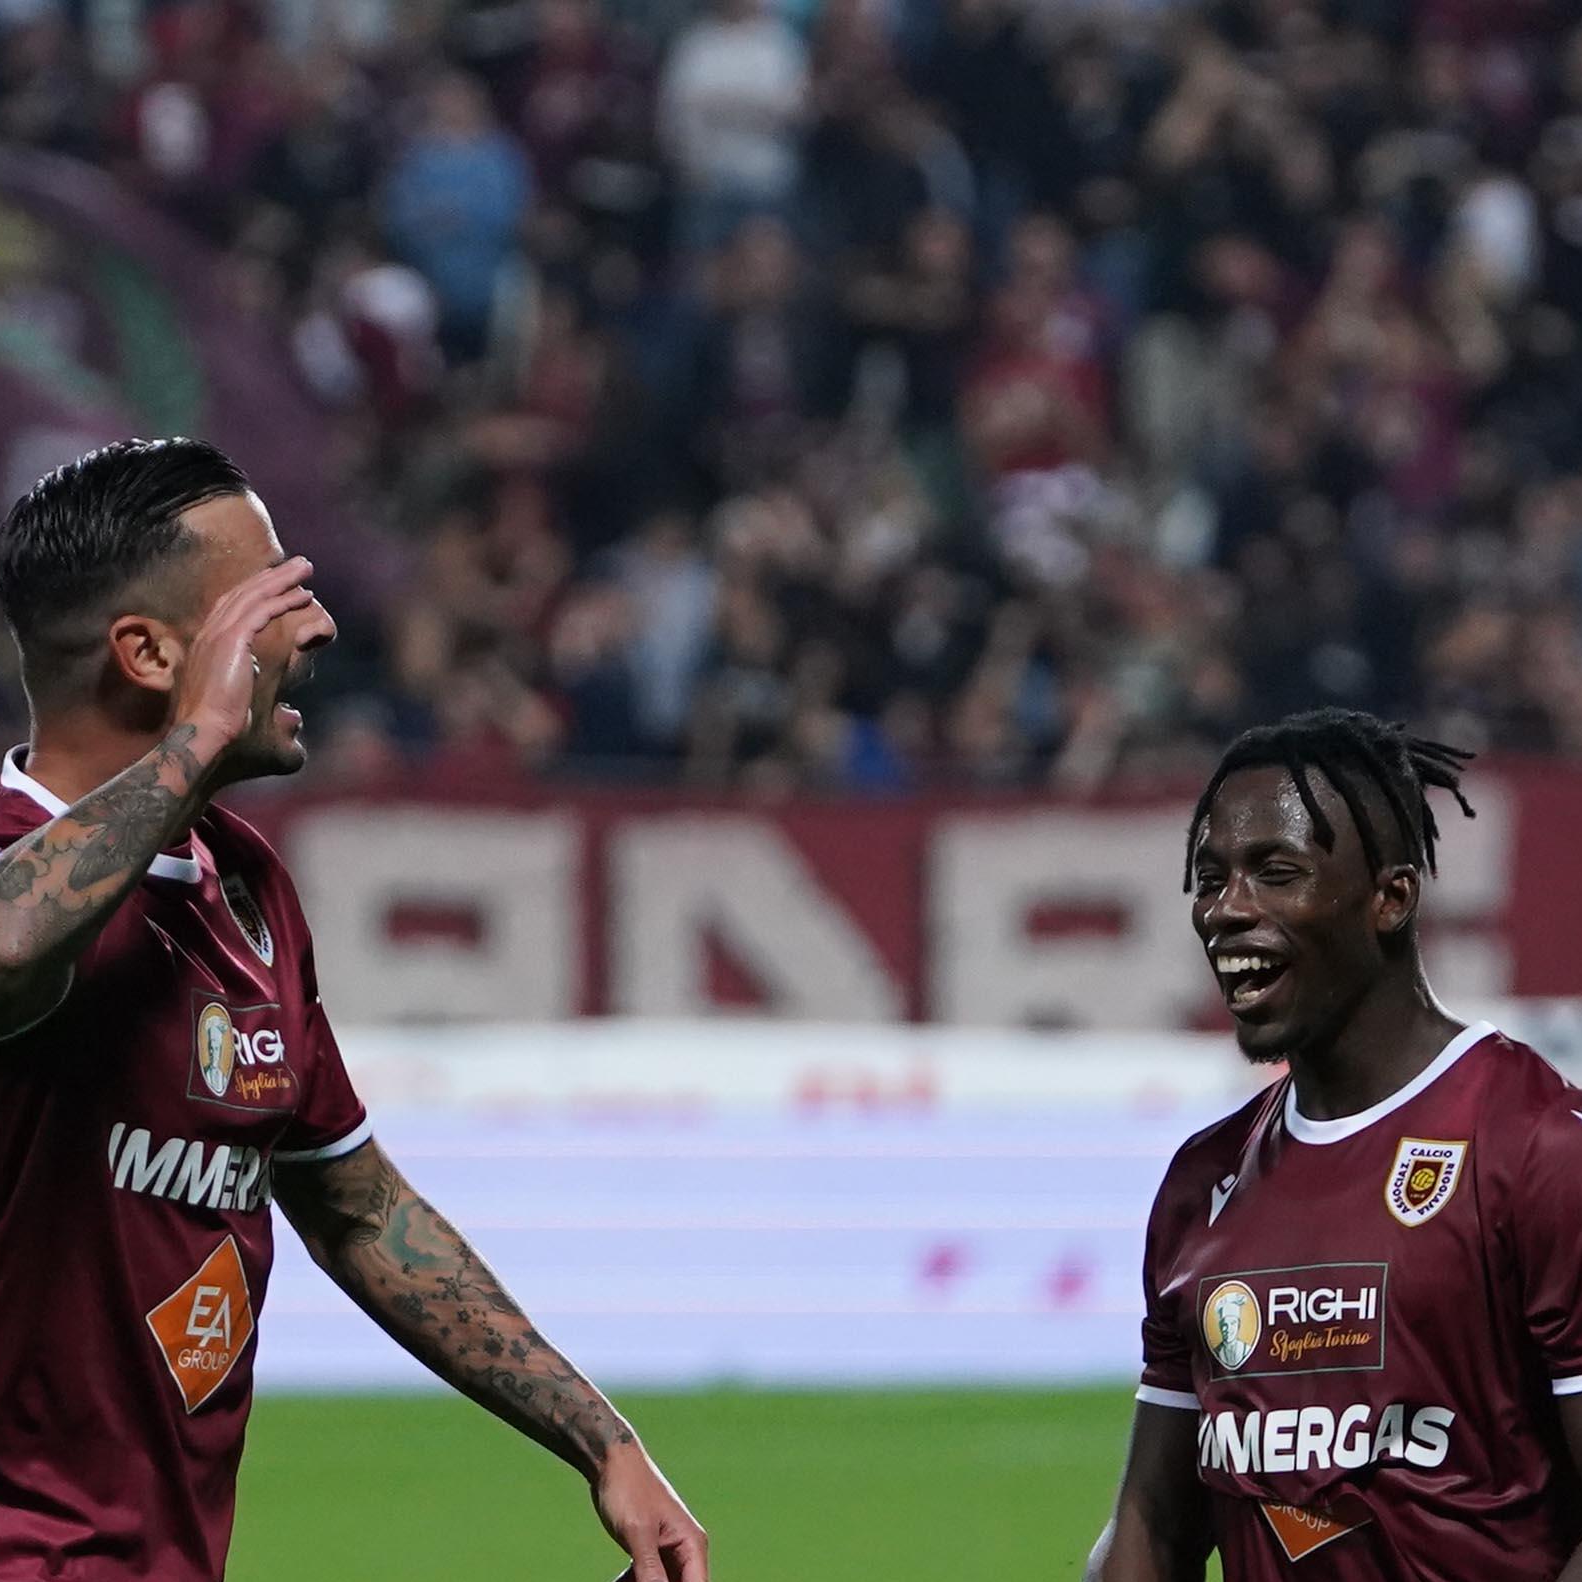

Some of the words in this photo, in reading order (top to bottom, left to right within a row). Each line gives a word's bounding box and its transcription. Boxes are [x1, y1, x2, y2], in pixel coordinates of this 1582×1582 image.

[1410, 1147, 1453, 1159] CALCIO
[185, 1284, 231, 1350] EA
[1268, 1286, 1378, 1327] RIGHI
[177, 1347, 231, 1374] GROUP
[1269, 1327, 1324, 1363] Sfoglia
[1321, 1324, 1374, 1350] Torino
